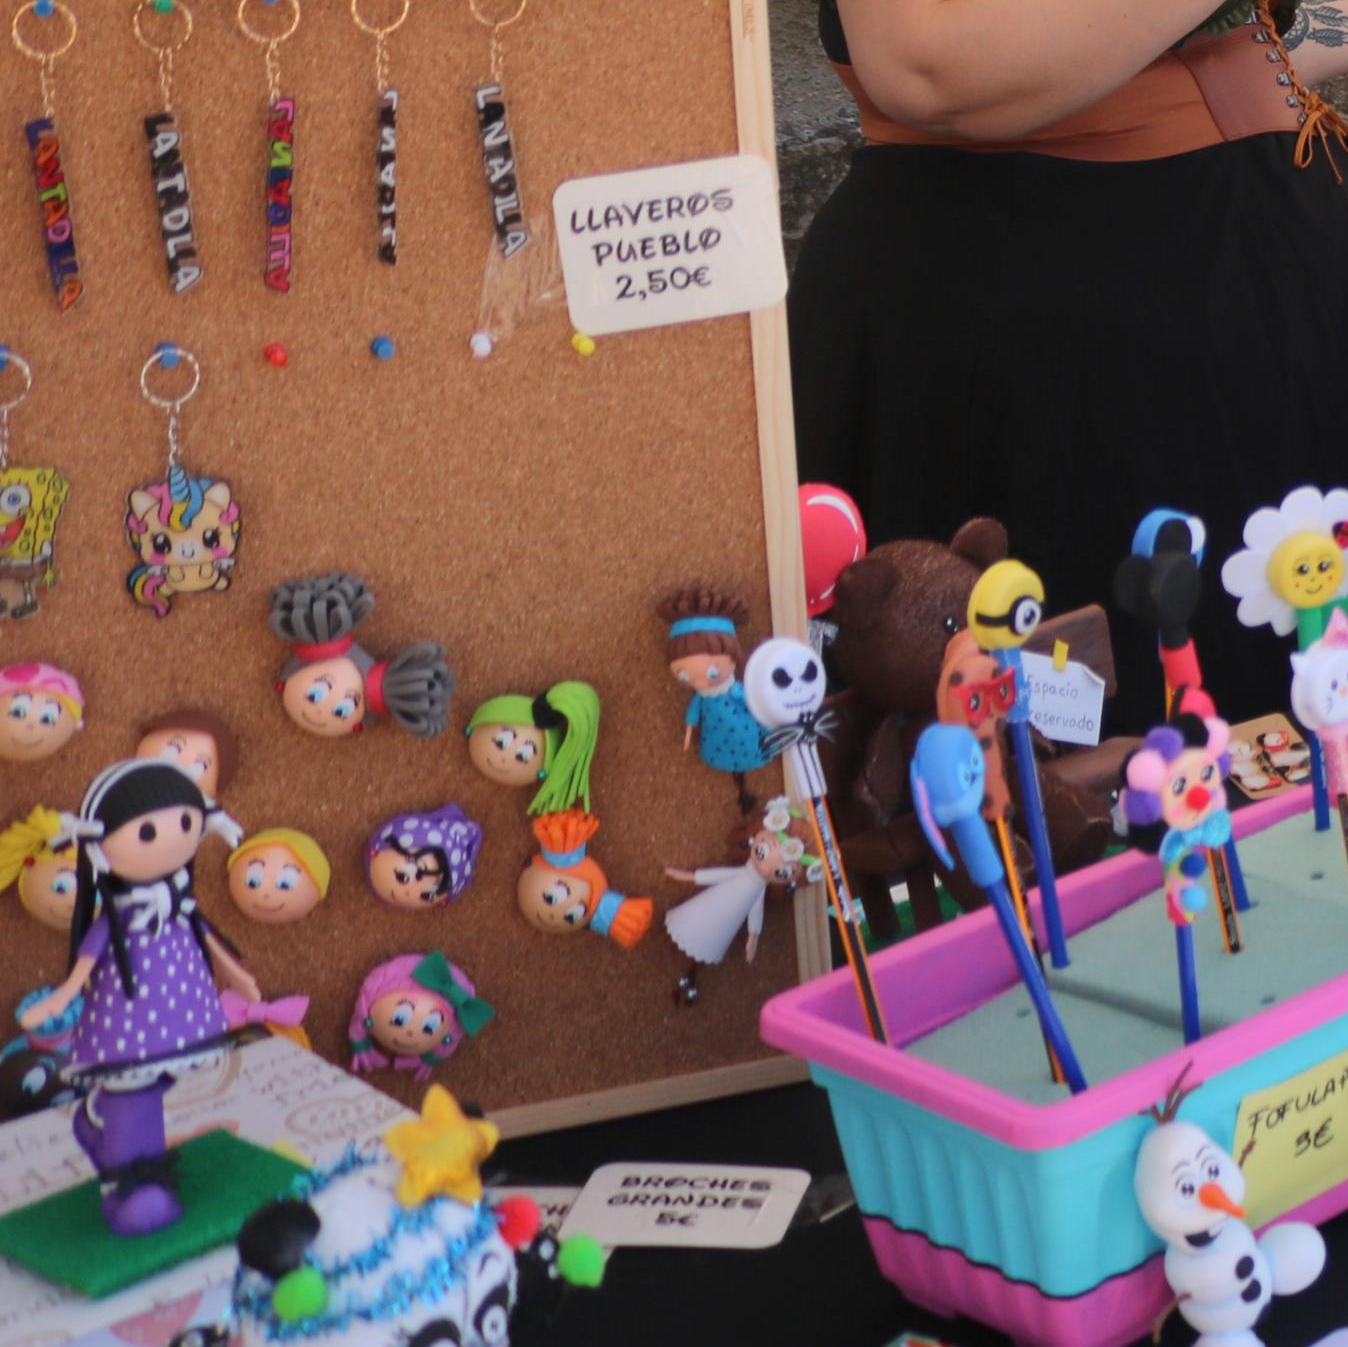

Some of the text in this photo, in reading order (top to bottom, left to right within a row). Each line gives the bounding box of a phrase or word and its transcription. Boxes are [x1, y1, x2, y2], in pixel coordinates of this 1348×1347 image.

[570, 188, 734, 234] LLAVEROS
[592, 227, 721, 266] PUEBLO
[616, 266, 712, 301] 2,50€
[620, 1175, 772, 1192] BROCHES
[606, 1193, 765, 1210] GRANDES
